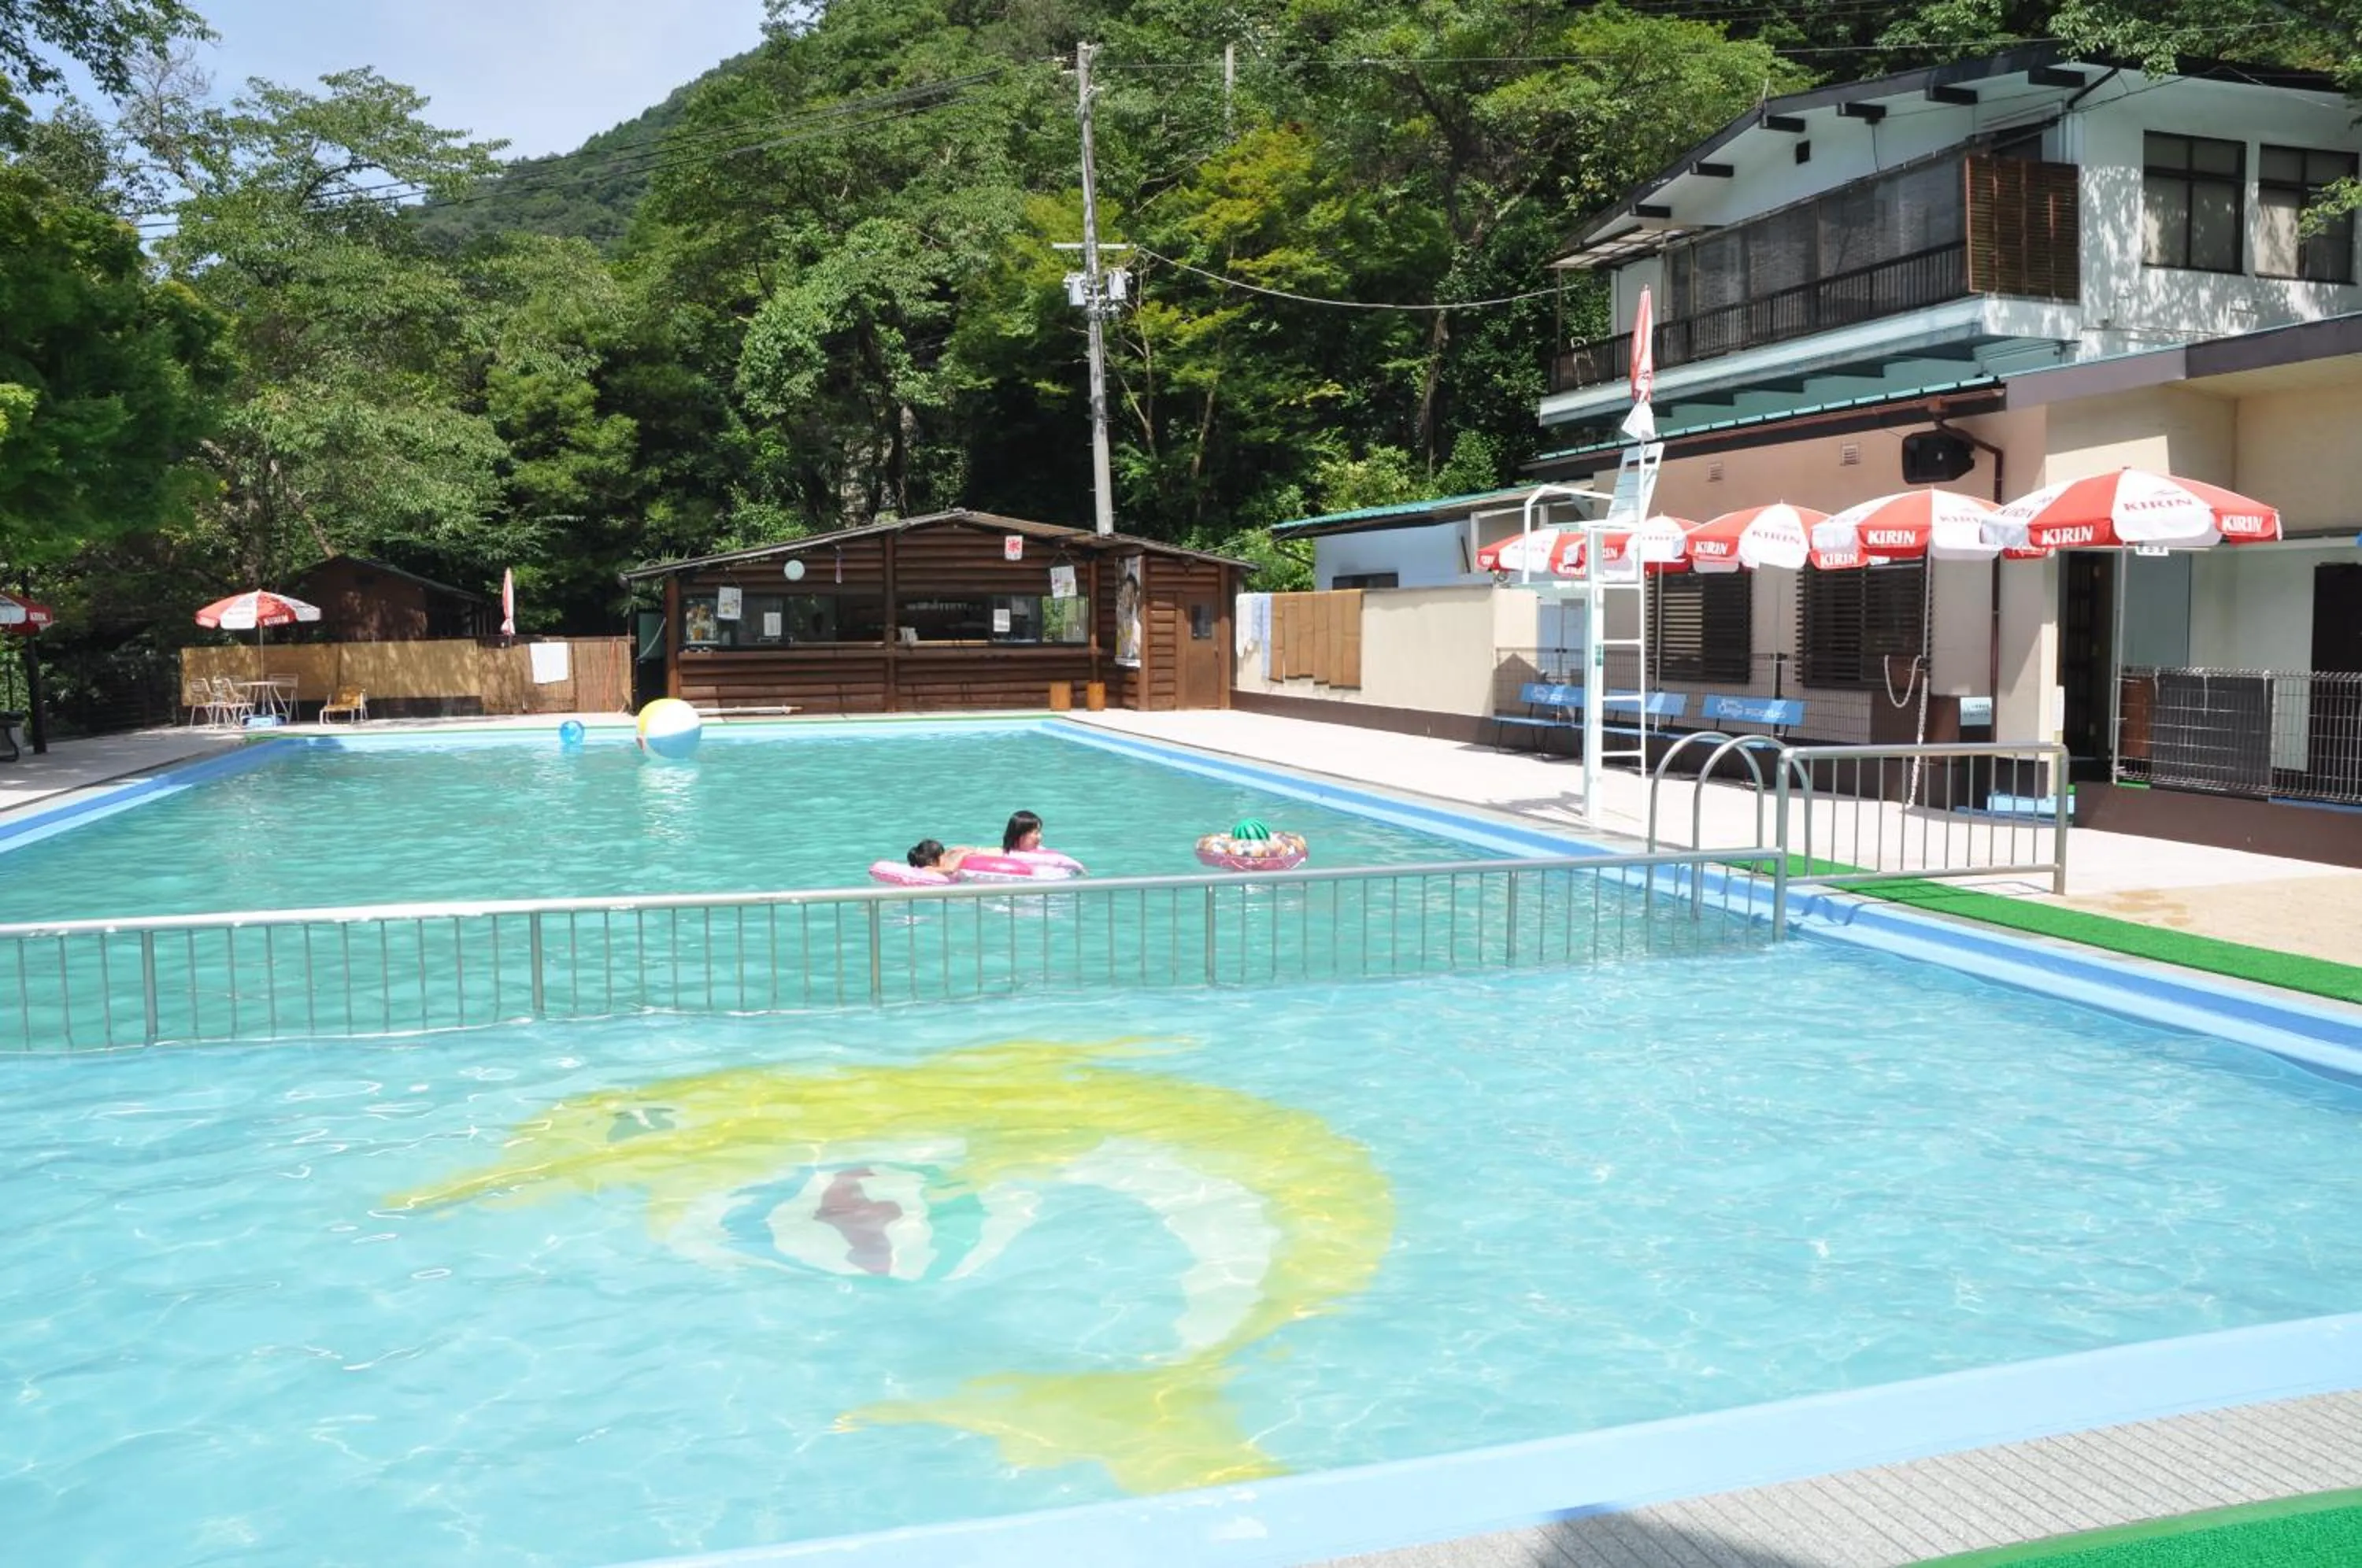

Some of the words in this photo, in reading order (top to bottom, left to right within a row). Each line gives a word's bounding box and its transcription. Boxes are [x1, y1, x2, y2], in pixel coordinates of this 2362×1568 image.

[2123, 498, 2193, 511] KIRIN
[2221, 515, 2264, 533] KIRIN
[1752, 530, 1801, 545] KIRIN
[1868, 530, 1916, 545] KIRIN
[2041, 525, 2094, 545] KIRIN
[1694, 540, 1729, 555] KIRIN
[1820, 553, 1858, 568] KIRIN
